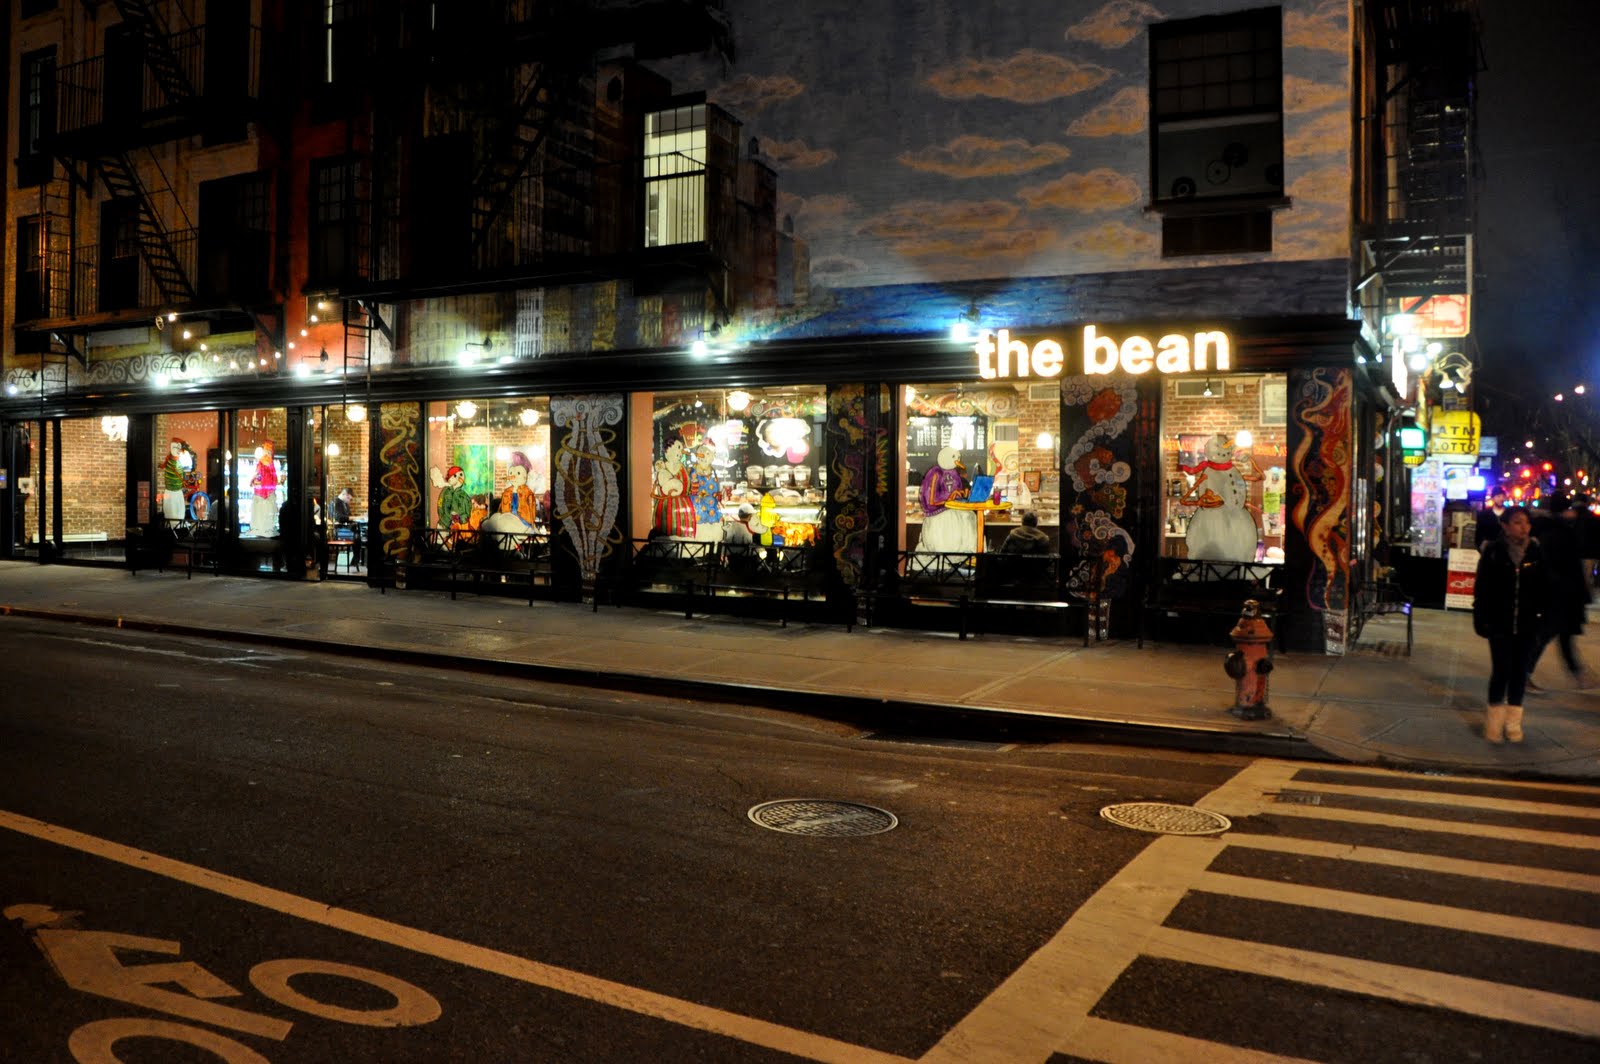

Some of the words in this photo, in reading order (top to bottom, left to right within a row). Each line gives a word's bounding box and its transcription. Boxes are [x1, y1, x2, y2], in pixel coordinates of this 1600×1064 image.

[975, 329, 1064, 379] the
[1083, 325, 1230, 375] bean
[1438, 425, 1476, 436] ATM
